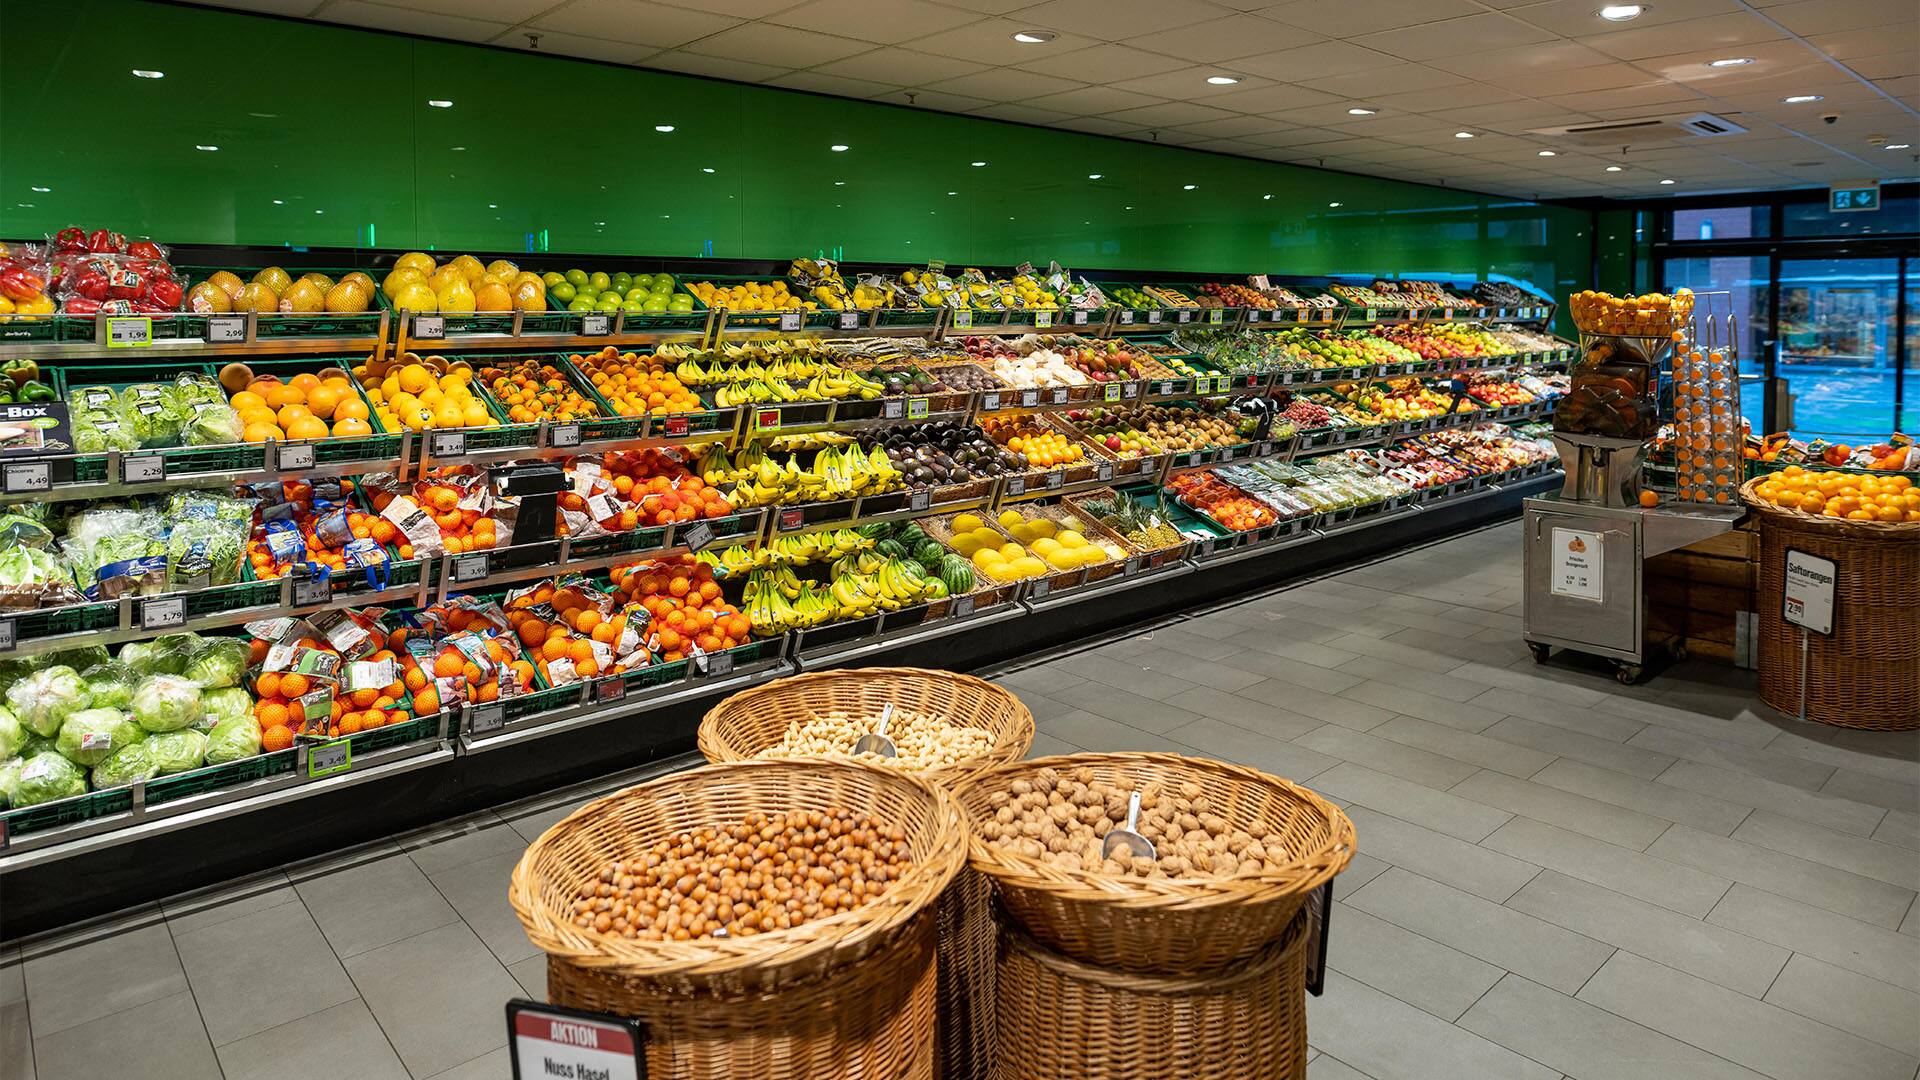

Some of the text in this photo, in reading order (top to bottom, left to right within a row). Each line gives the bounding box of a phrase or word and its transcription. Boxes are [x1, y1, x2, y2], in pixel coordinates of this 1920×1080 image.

[129, 331, 147, 339] 1,99
[143, 467, 162, 476] 2,29
[26, 477, 47, 485] 4,49
[1788, 562, 1833, 585] Saftorangen
[311, 590, 329, 599] 3,99
[162, 611, 182, 621] 1,79
[329, 754, 346, 765] 3,49
[551, 1021, 598, 1048] AKTION
[544, 1057, 574, 1078] Nuss
